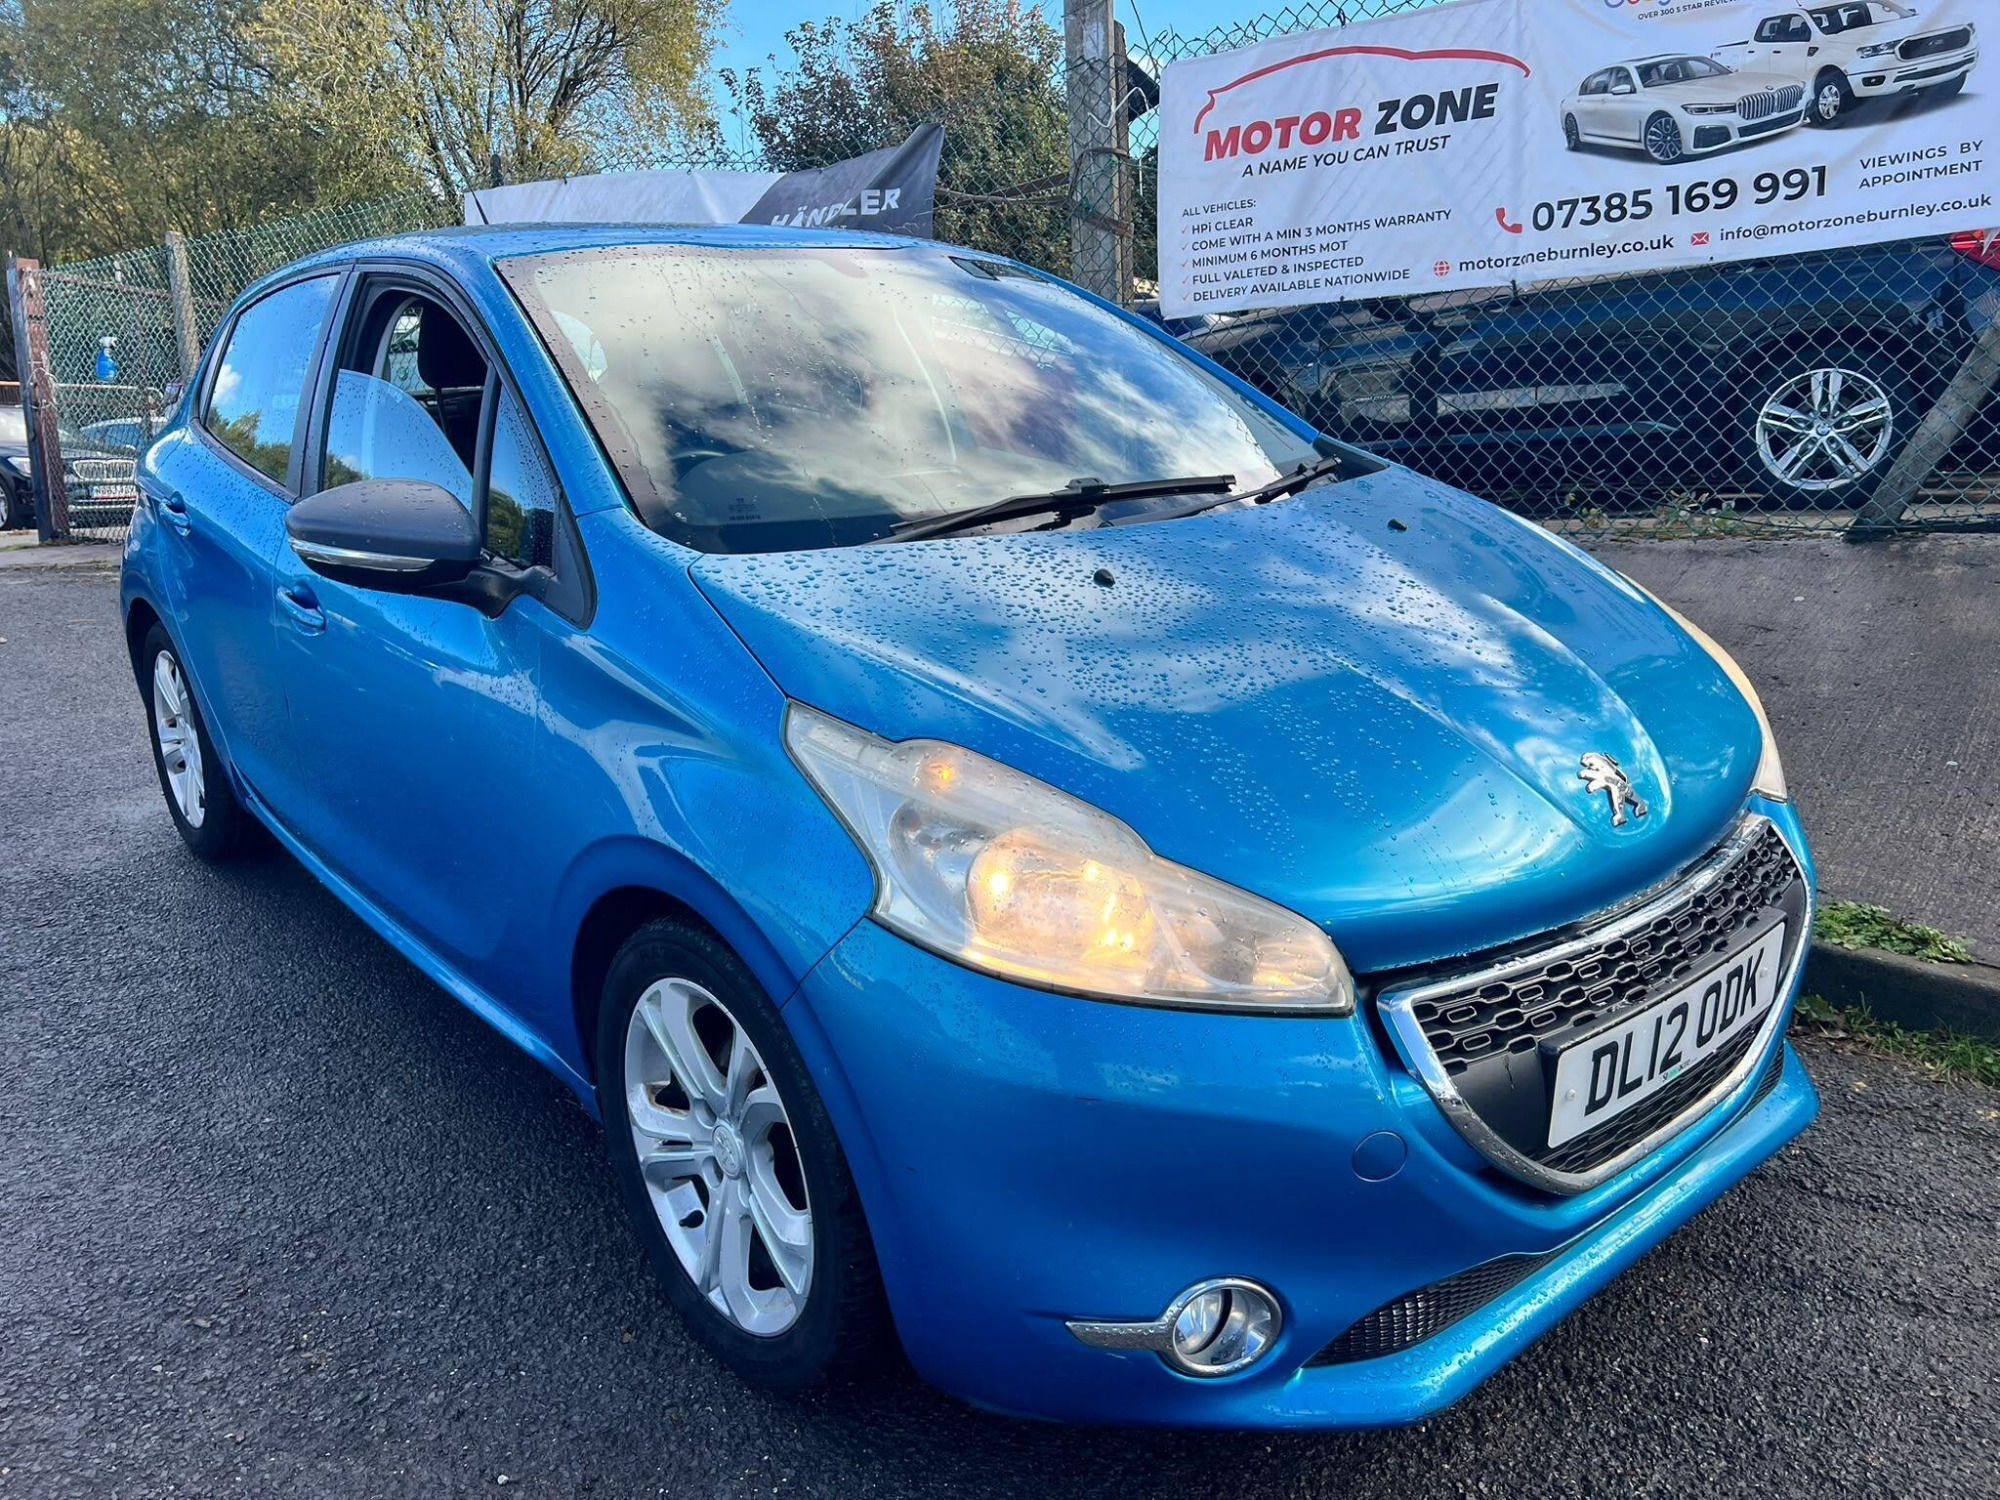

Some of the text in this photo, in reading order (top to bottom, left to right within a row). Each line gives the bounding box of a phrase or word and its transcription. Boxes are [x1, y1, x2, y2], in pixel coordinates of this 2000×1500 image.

[1638, 10, 1659, 20] OVER
[1660, 8, 1675, 17] 300
[1676, 6, 1681, 14] 5
[1682, 2, 1703, 12] STAR
[1704, 0, 1737, 8] REVIE
[1203, 82, 1499, 162] MOTOR ZONE
[1241, 134, 1452, 178] A NAME YOU CAN TRUST
[1859, 140, 1983, 170] VIEWINGS BY
[1859, 160, 1983, 189] APPOINTMENT
[770, 187, 901, 228] HÄNDLER
[1182, 199, 1257, 217] ALL VEHICLES:
[1532, 165, 1827, 232] 07385 169 991
[1191, 217, 1253, 235] HPi CLEAR
[1191, 209, 1452, 251] COME WITH A MIN 3 MONTHS WARRANTY
[1720, 193, 1992, 241] info@motorzoneburnley.co.uk
[1192, 240, 1348, 268] MINIMUM 6 MONTHS MOT
[1192, 256, 1364, 285] FULL VALETED & INSPECTED
[1193, 269, 1411, 302] DELIVERY AVAILABLE NATIONWIDE
[1584, 947, 1765, 1117] DL12 ODK
